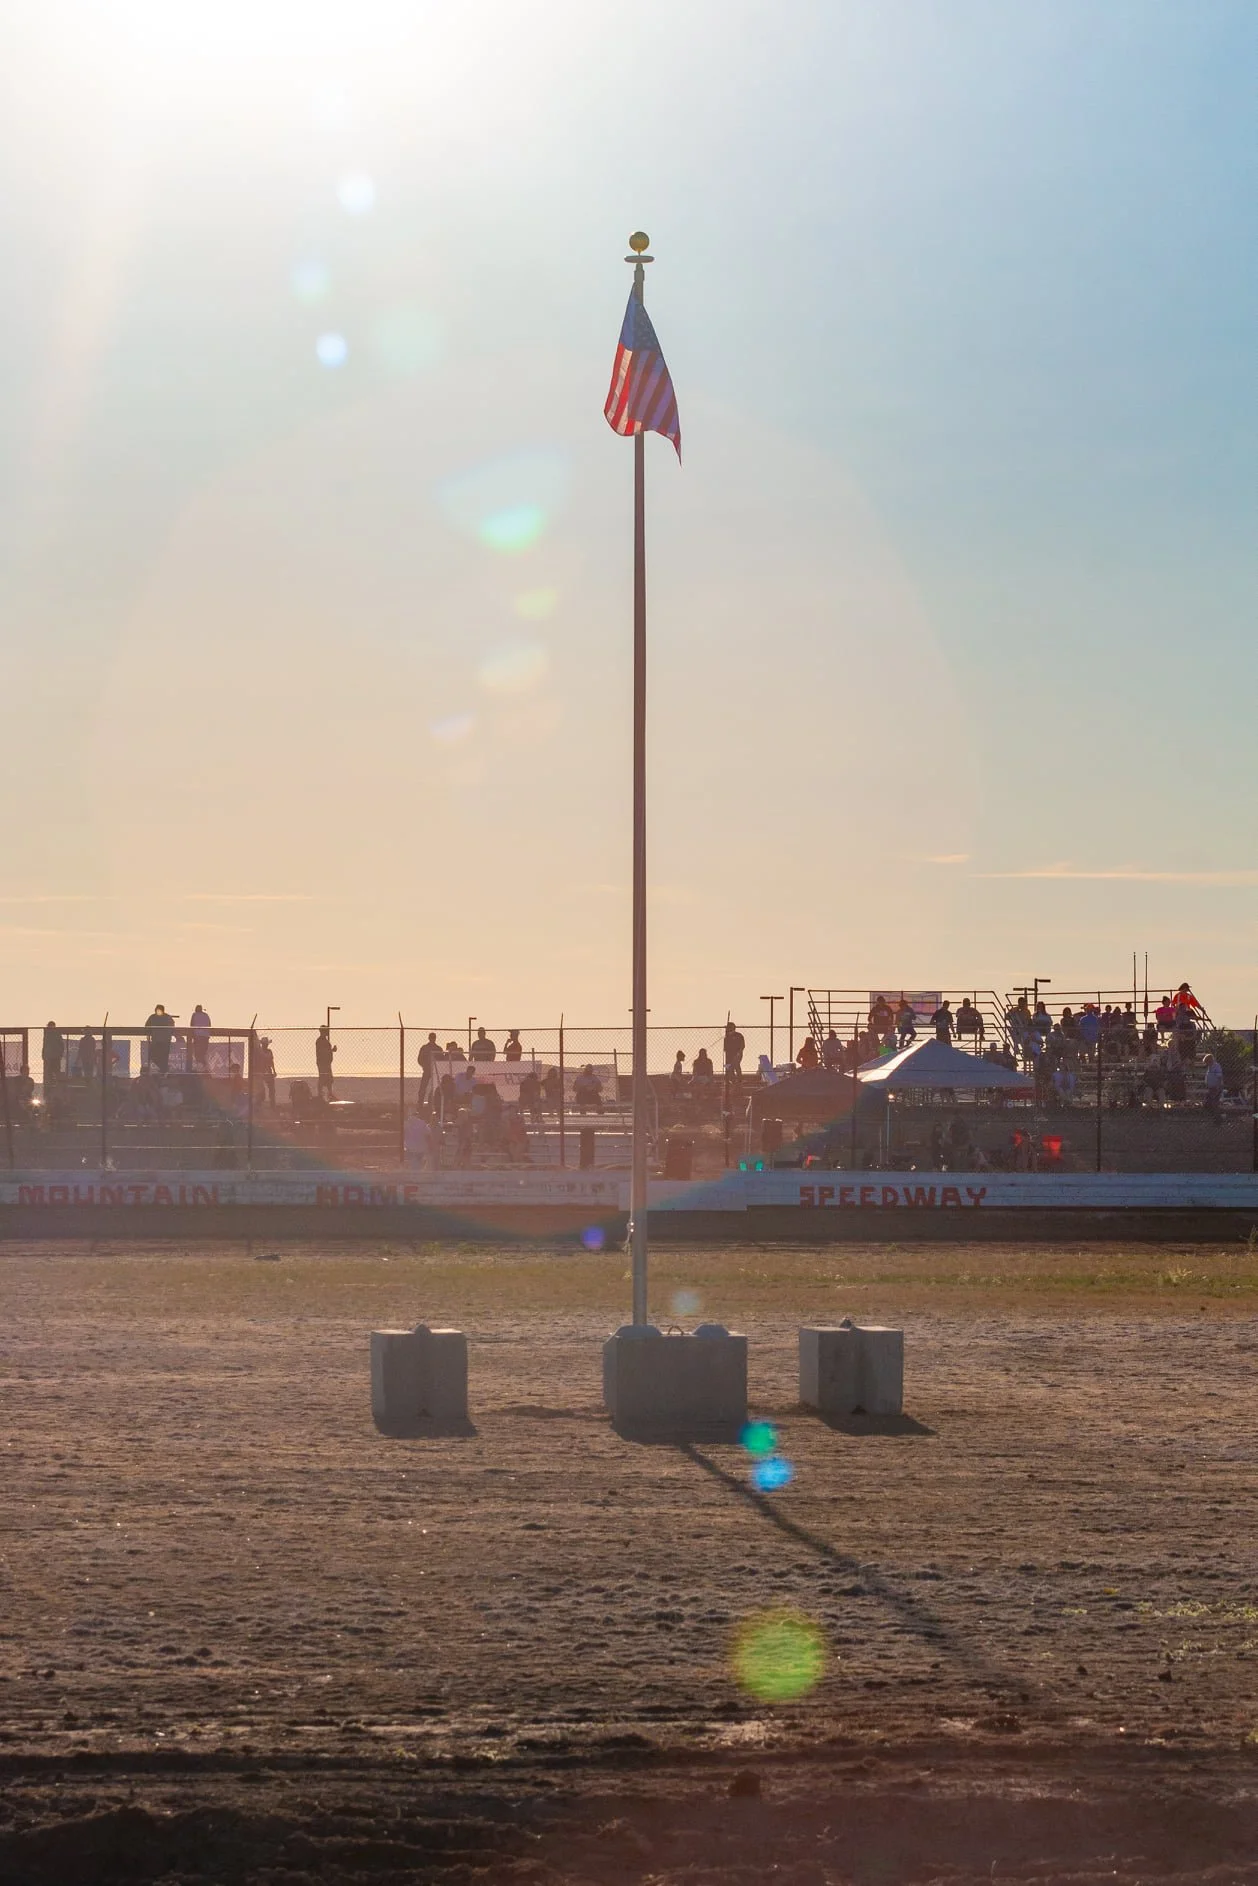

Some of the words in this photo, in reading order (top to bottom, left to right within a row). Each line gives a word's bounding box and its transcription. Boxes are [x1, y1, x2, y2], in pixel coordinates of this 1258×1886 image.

[18, 1185, 219, 1207] MOUNTAIN
[316, 1185, 418, 1207] HOME
[800, 1186, 987, 1208] SPEEDWAY
